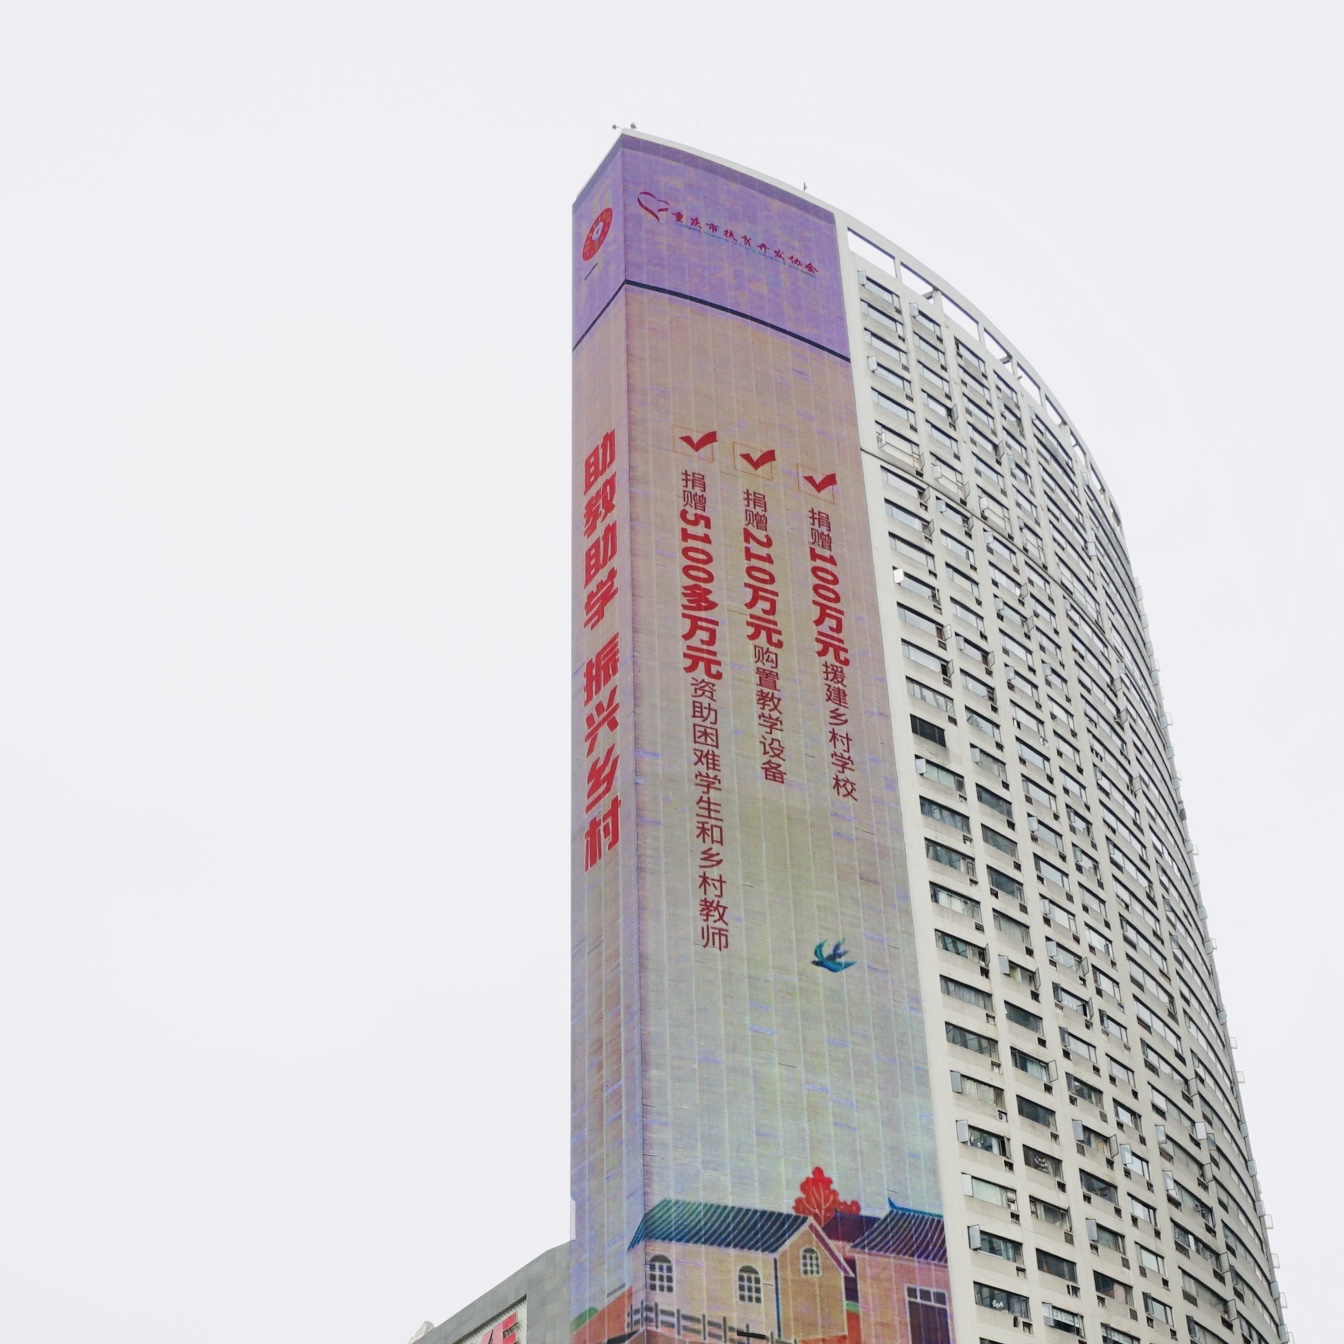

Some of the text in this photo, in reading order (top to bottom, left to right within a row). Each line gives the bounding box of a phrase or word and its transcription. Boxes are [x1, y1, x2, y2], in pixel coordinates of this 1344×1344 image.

[583, 428, 621, 872] 助教助学 振兴乡村
[679, 469, 729, 952] 捐赠5100多万元资助困难学生和乡村教师
[742, 489, 787, 785] 捐赠210万元购置教学设备
[808, 508, 858, 802] 捐赠100万元援建乡村学校
